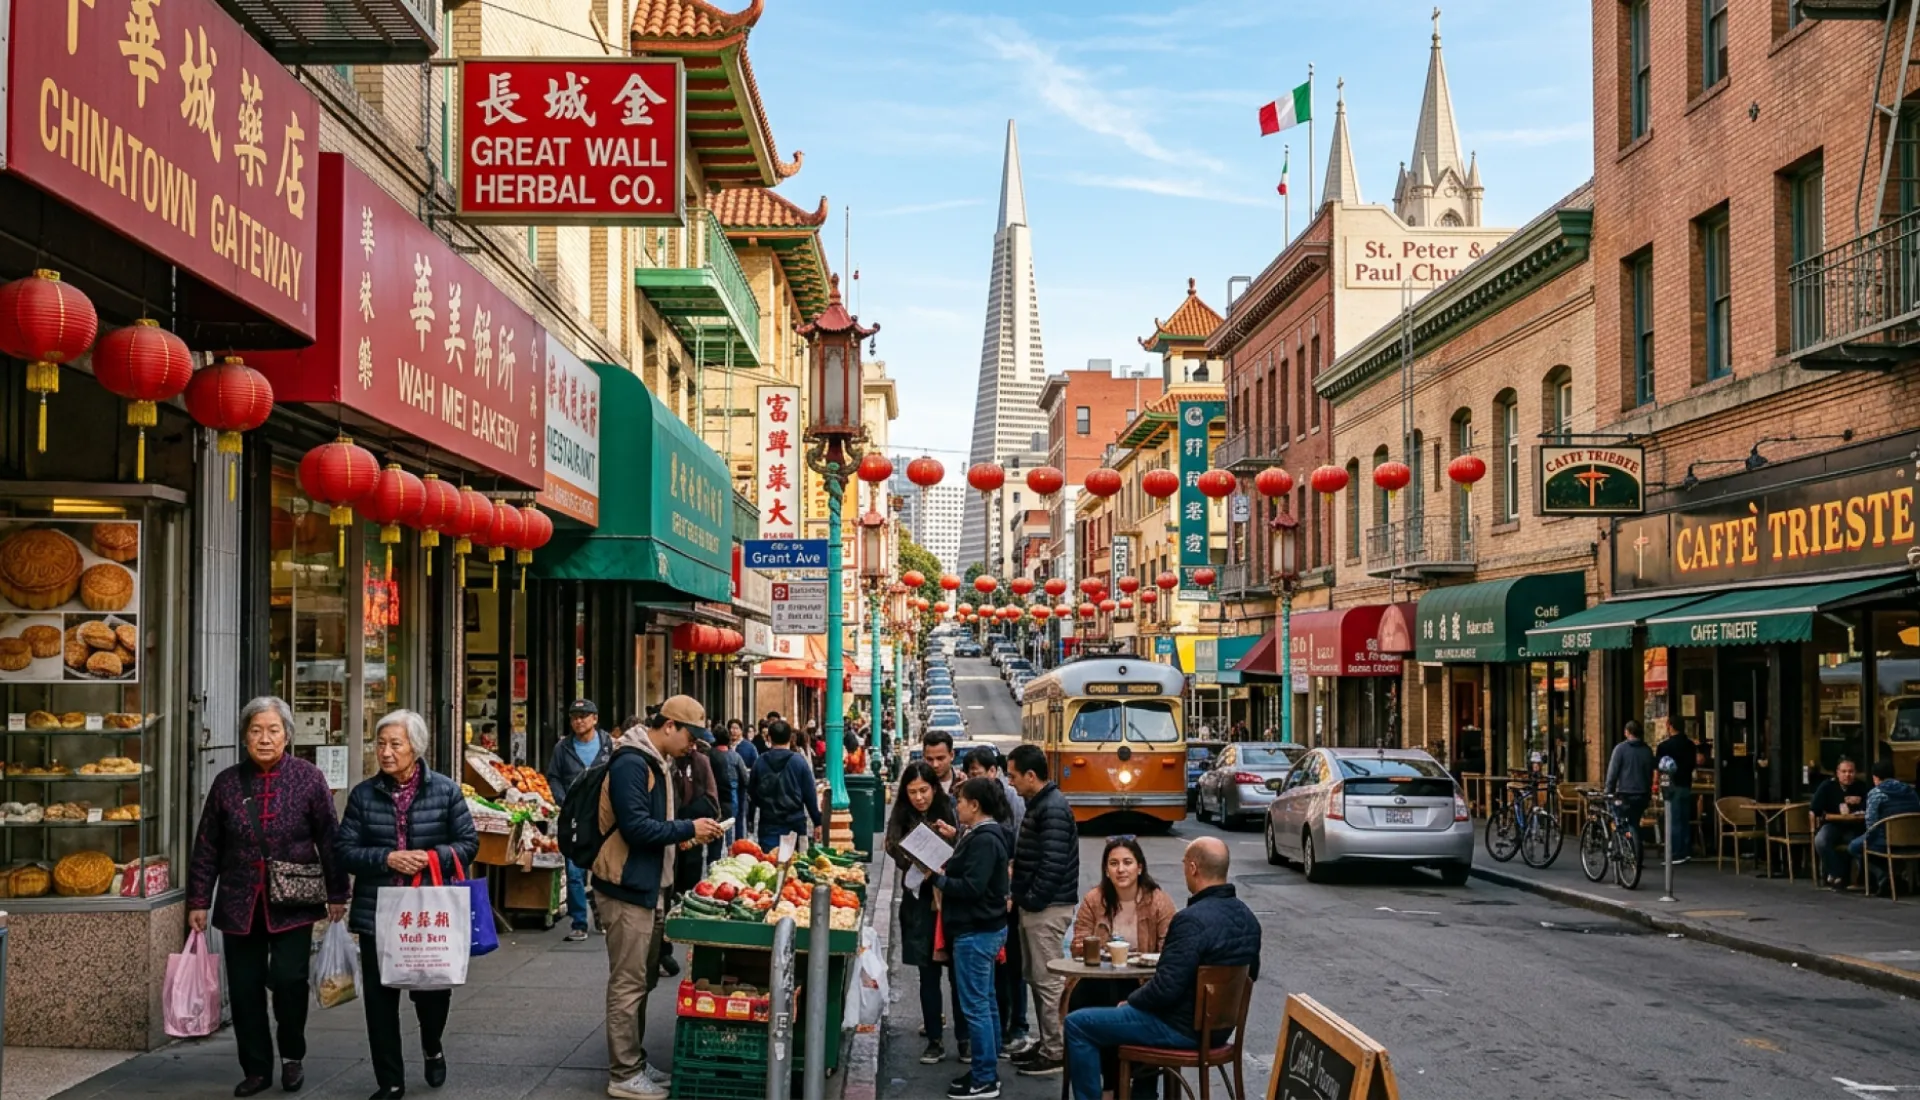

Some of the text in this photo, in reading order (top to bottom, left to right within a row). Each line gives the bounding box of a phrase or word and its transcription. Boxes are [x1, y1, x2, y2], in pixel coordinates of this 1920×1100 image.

[471, 136, 667, 166] GREAT WALL
[40, 77, 303, 302] CHINATOWN GATEWAY
[475, 175, 662, 205] HERBAL CO.
[1365, 240, 1485, 259] St. Peter &
[1355, 263, 1401, 281] Paul
[398, 358, 519, 456] WAH MEI BAKERY
[1676, 486, 1915, 574] CAFFÈ TRIESTE
[752, 552, 821, 564] Grant Ave
